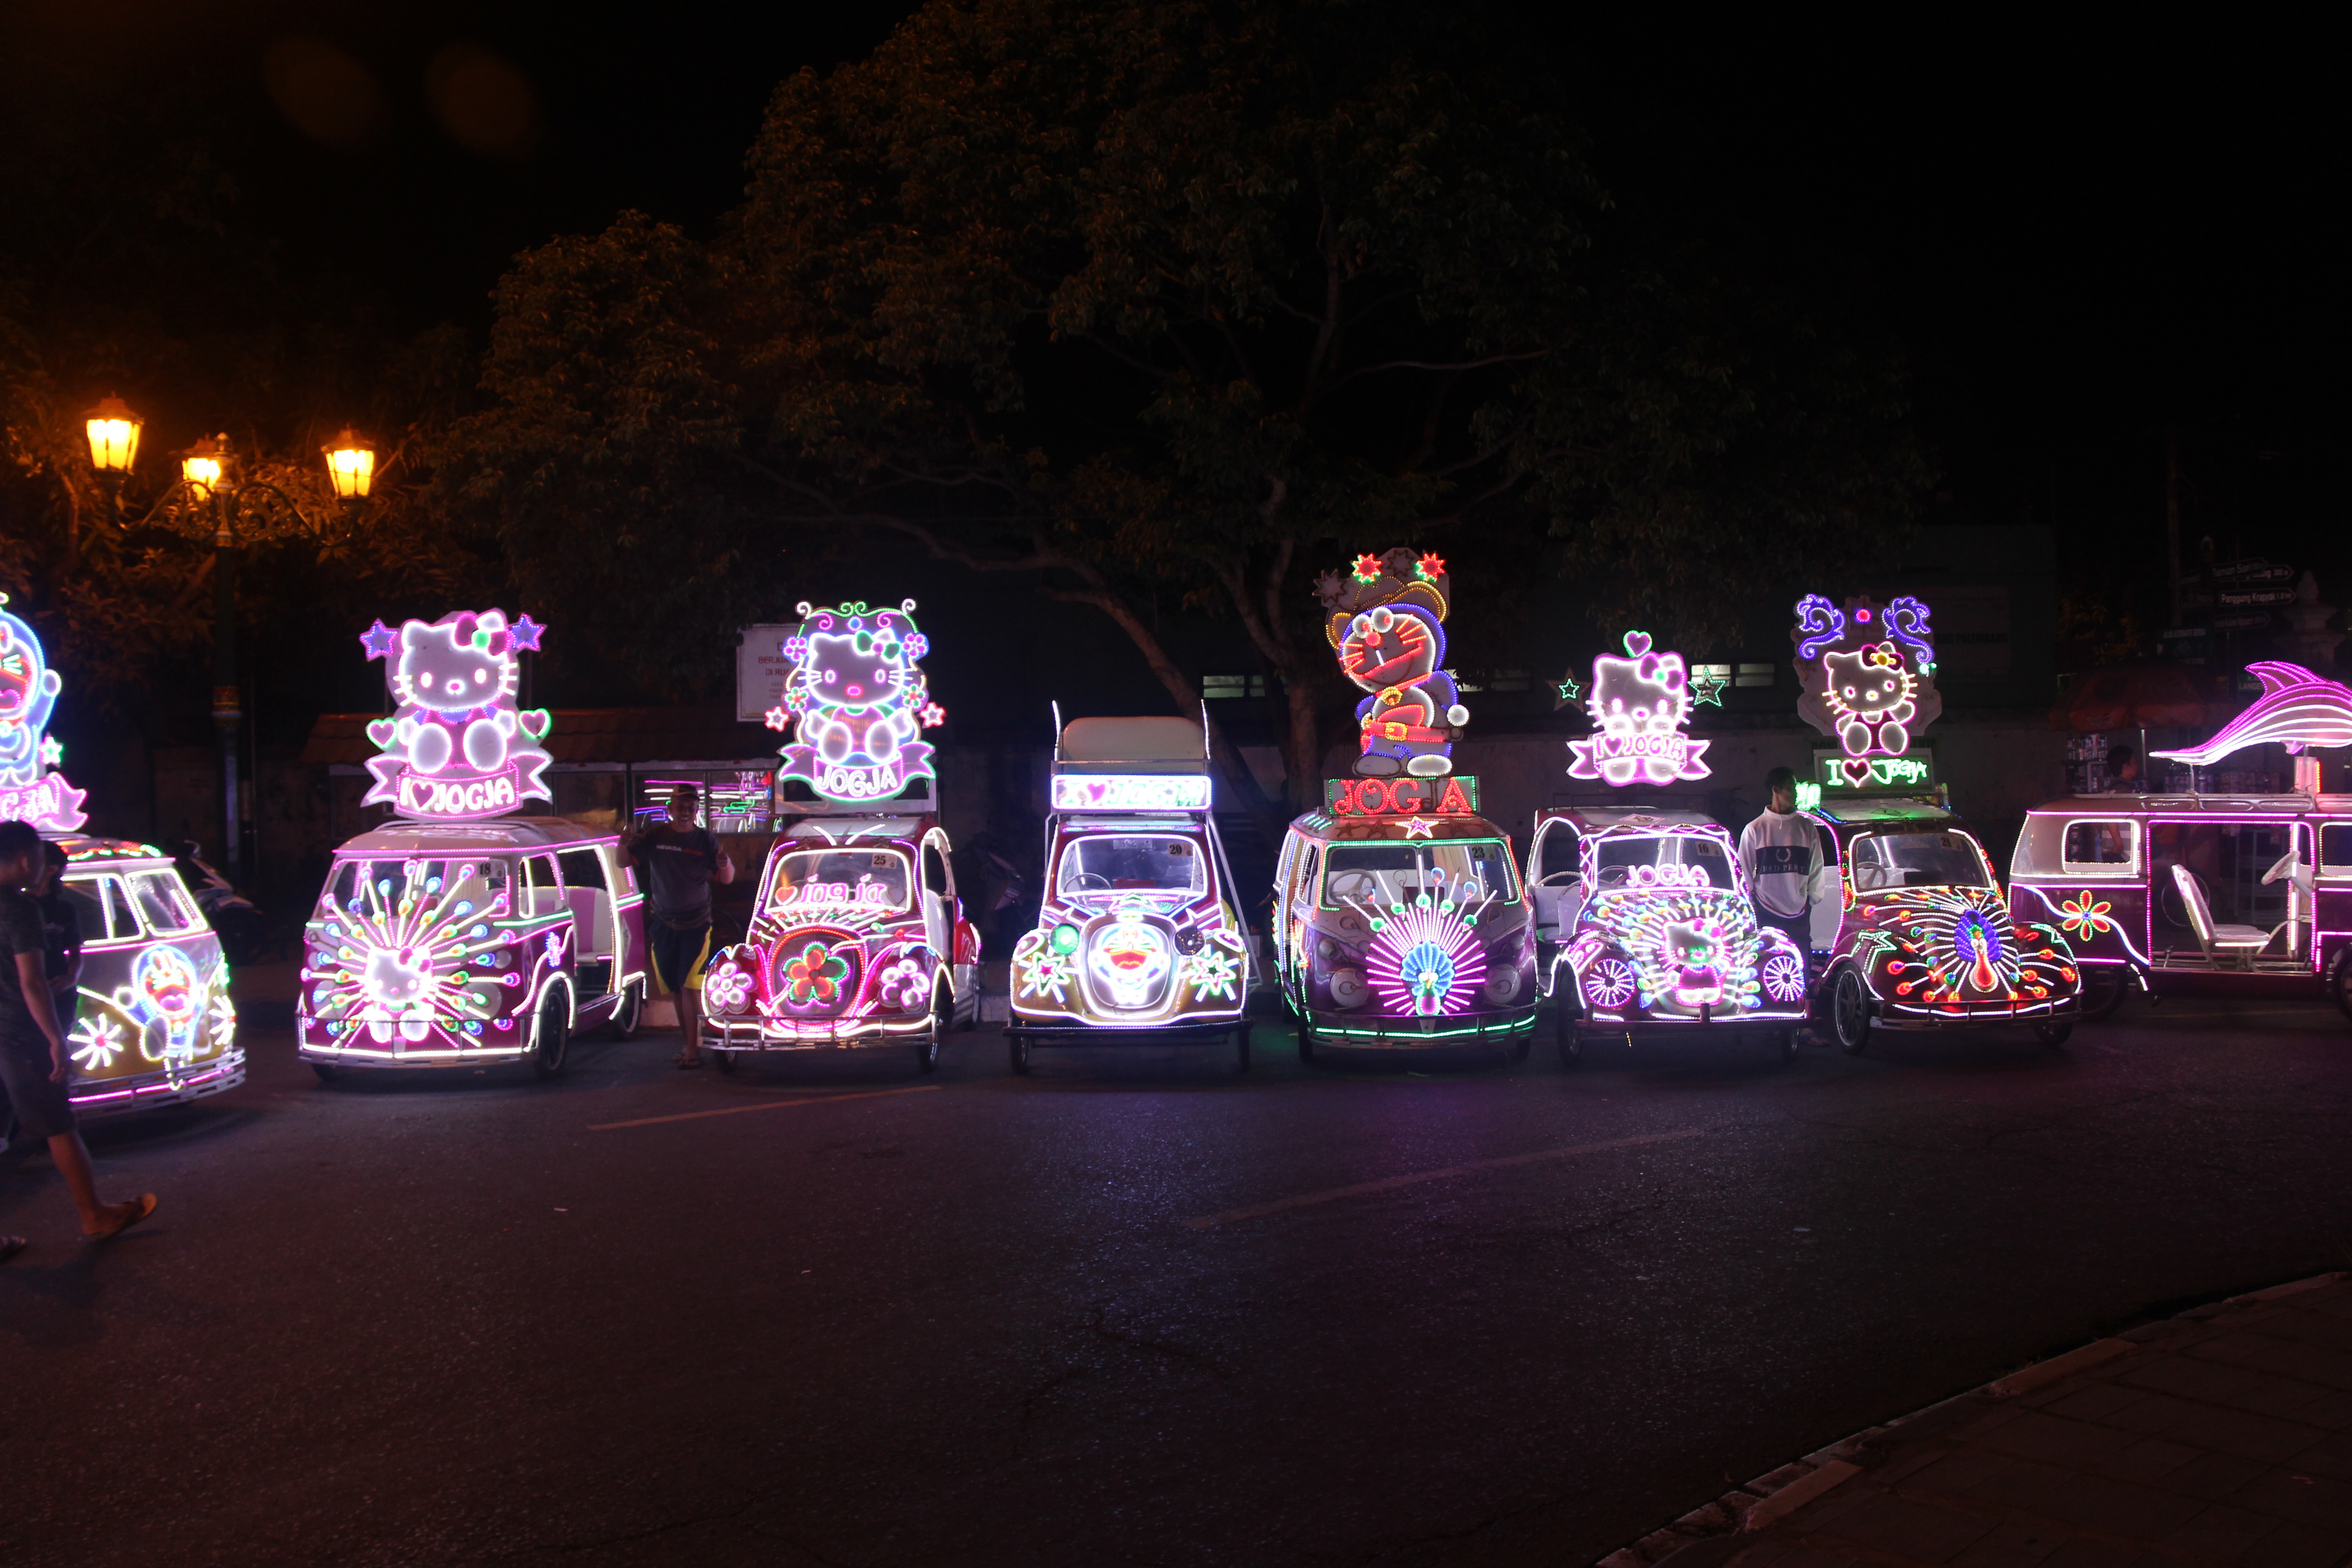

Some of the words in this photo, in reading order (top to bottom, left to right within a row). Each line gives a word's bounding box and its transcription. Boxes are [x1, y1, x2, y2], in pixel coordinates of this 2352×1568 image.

[2221, 593, 2251, 604] Panggung
[2252, 592, 2276, 603] Krapyak
[1622, 736, 1683, 761] JOGJA
[1825, 759, 1844, 786] I
[817, 764, 898, 798] JOGJA
[399, 777, 411, 806] I
[434, 776, 515, 814] JOGJA
[1940, 837, 1952, 847] 21
[1169, 844, 1182, 854] 20
[1471, 847, 1485, 858] 23
[1697, 843, 1710, 854] 16
[873, 855, 886, 865] 25
[479, 862, 491, 875] 18
[1625, 862, 1710, 888] JOGJA
